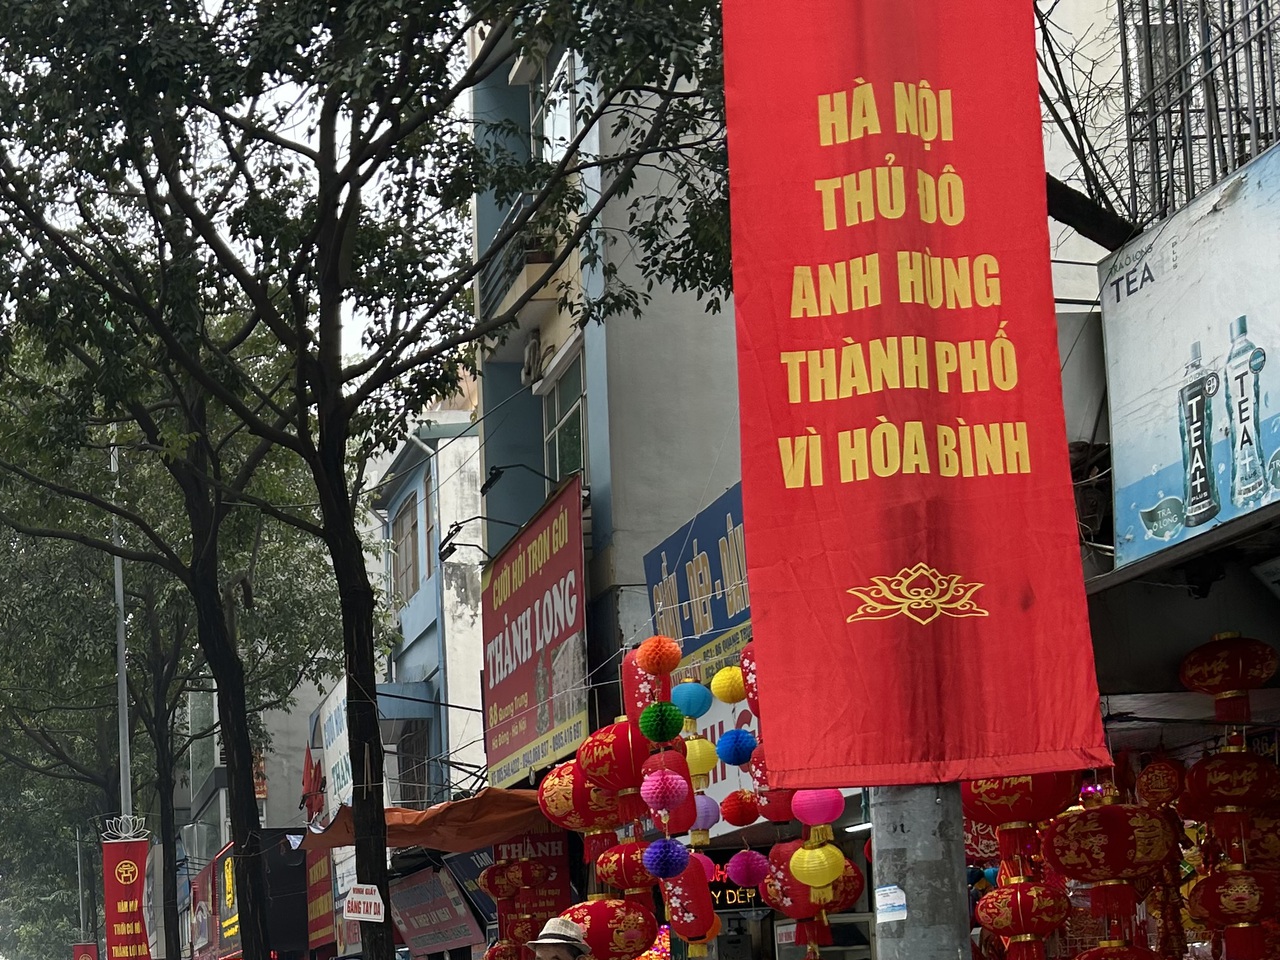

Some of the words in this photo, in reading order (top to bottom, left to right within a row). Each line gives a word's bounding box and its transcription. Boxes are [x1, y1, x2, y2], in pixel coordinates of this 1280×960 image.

[818, 77, 881, 146] HÀ
[894, 79, 954, 150] NỘI
[815, 153, 906, 231] THỦ
[917, 165, 965, 226] ĐÔ
[791, 254, 881, 318] ANH
[897, 247, 1001, 309] HÙNG
[1110, 261, 1155, 303] TEA
[781, 336, 928, 403] THÀNH
[935, 320, 1018, 393] PHỐ
[778, 427, 823, 489] VÌ
[838, 416, 929, 483] HÒA
[937, 417, 1031, 478] BÌNH
[493, 561, 511, 611] CƯỚI
[512, 544, 526, 592] HỎI
[527, 525, 550, 577] TRỌN
[552, 505, 569, 554] GÓI
[686, 538, 713, 637] DÉP
[534, 570, 577, 650] LONG
[489, 702, 498, 727] 88
[363, 901, 373, 915] TAY
